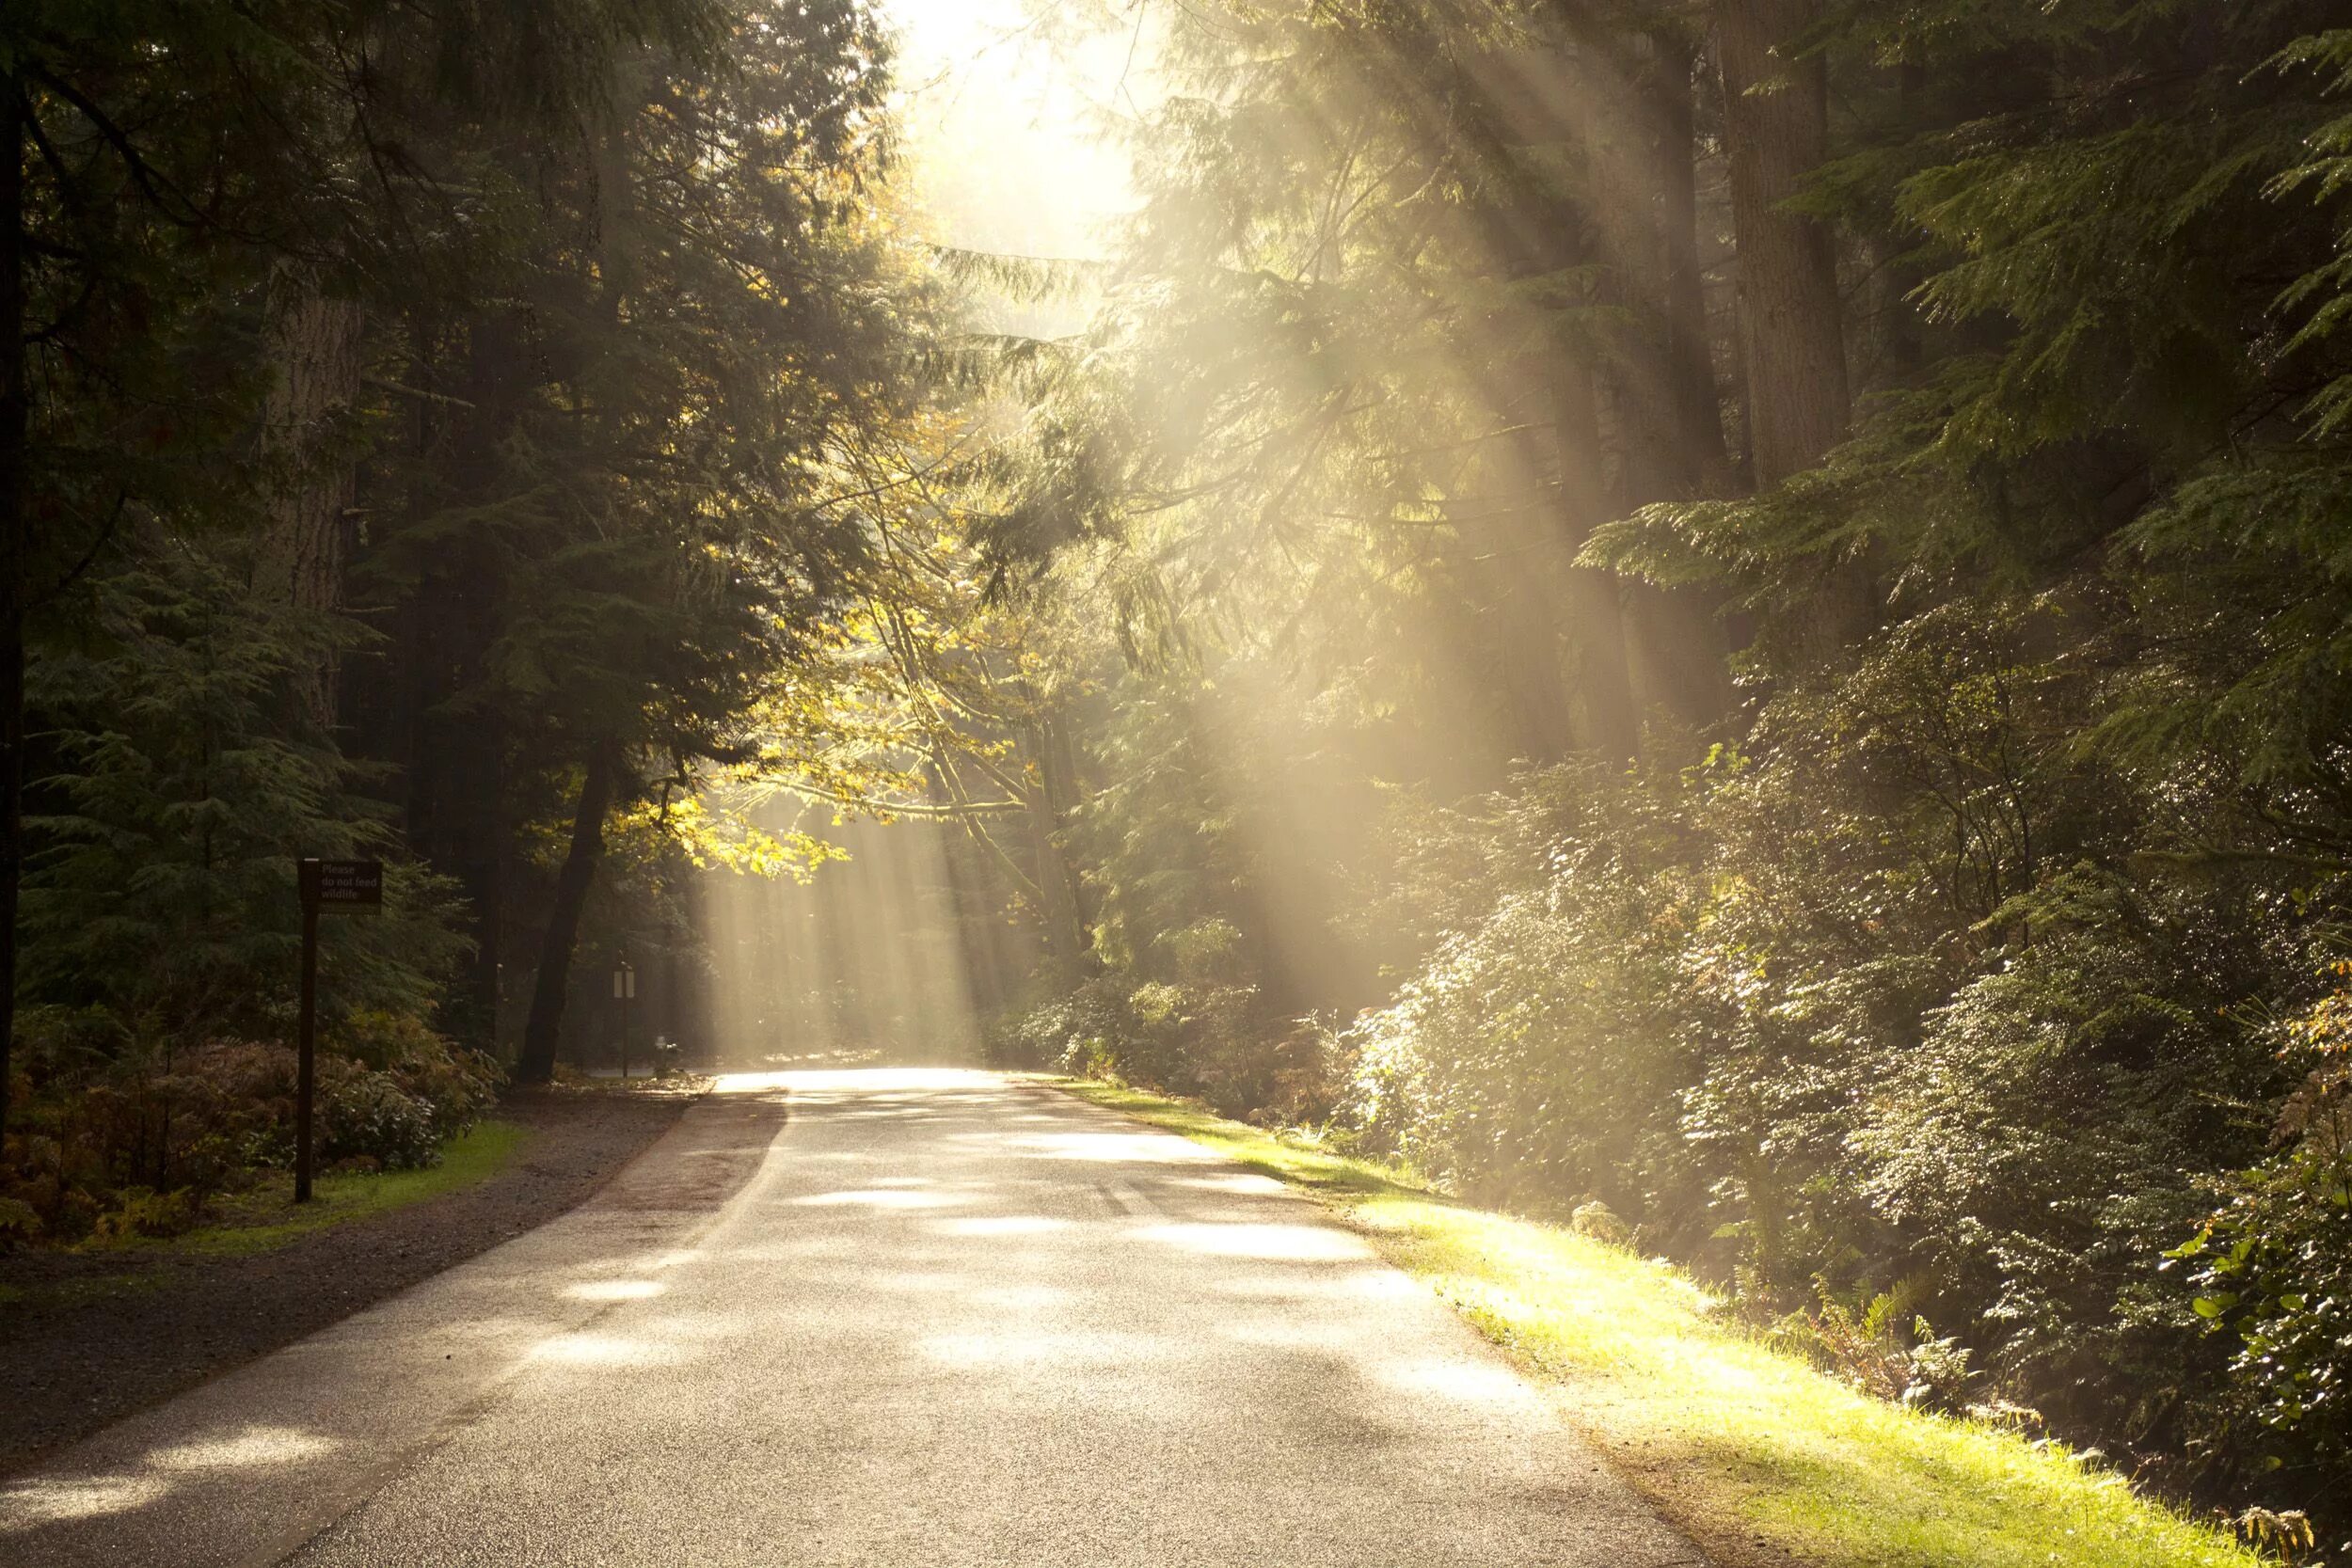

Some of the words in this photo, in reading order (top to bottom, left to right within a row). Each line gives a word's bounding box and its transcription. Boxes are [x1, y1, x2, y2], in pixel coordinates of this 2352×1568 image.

[322, 864, 355, 874] Please
[322, 877, 334, 886] do
[337, 878, 353, 886] not
[355, 877, 377, 887] feed
[321, 888, 358, 898] wildlife
